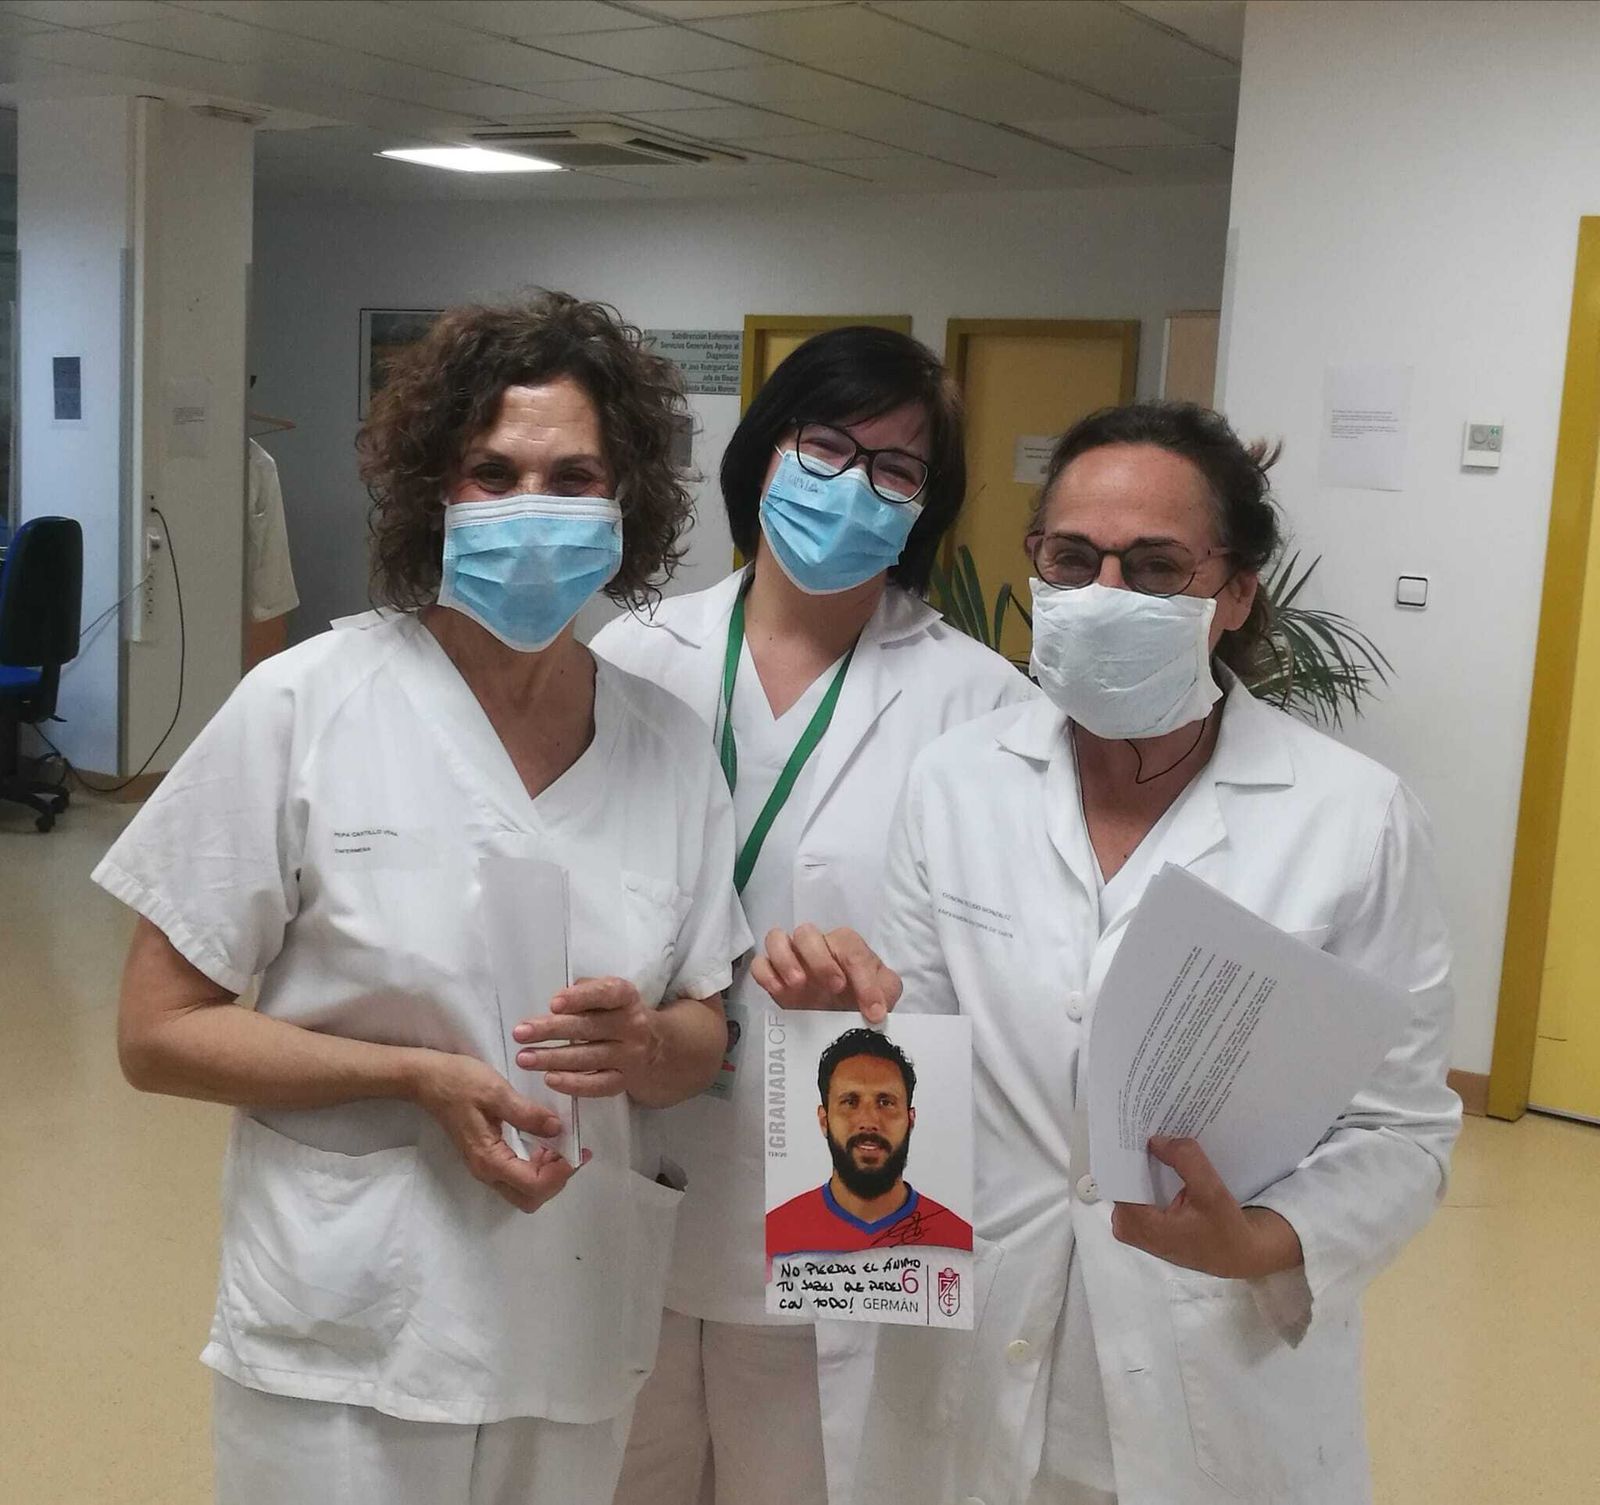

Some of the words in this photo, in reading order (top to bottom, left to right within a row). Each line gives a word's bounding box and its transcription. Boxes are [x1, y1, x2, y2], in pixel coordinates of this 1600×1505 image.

[660, 340, 685, 350] Servicios
[686, 341, 714, 350] Generales
[714, 341, 733, 351] Apoyo
[351, 829, 382, 837] CASTILLO
[768, 1015, 786, 1045] CF
[768, 1048, 786, 1149] GRANADA
[781, 1262, 800, 1278] NO
[863, 1262, 878, 1273] EL
[776, 1280, 794, 1292] TU
[801, 1280, 834, 1292] SABES
[844, 1281, 864, 1293] QUE
[902, 1268, 919, 1294] 6
[779, 1298, 803, 1310] CON
[813, 1296, 854, 1314] TODO!
[863, 1297, 919, 1313] GERMÁN
